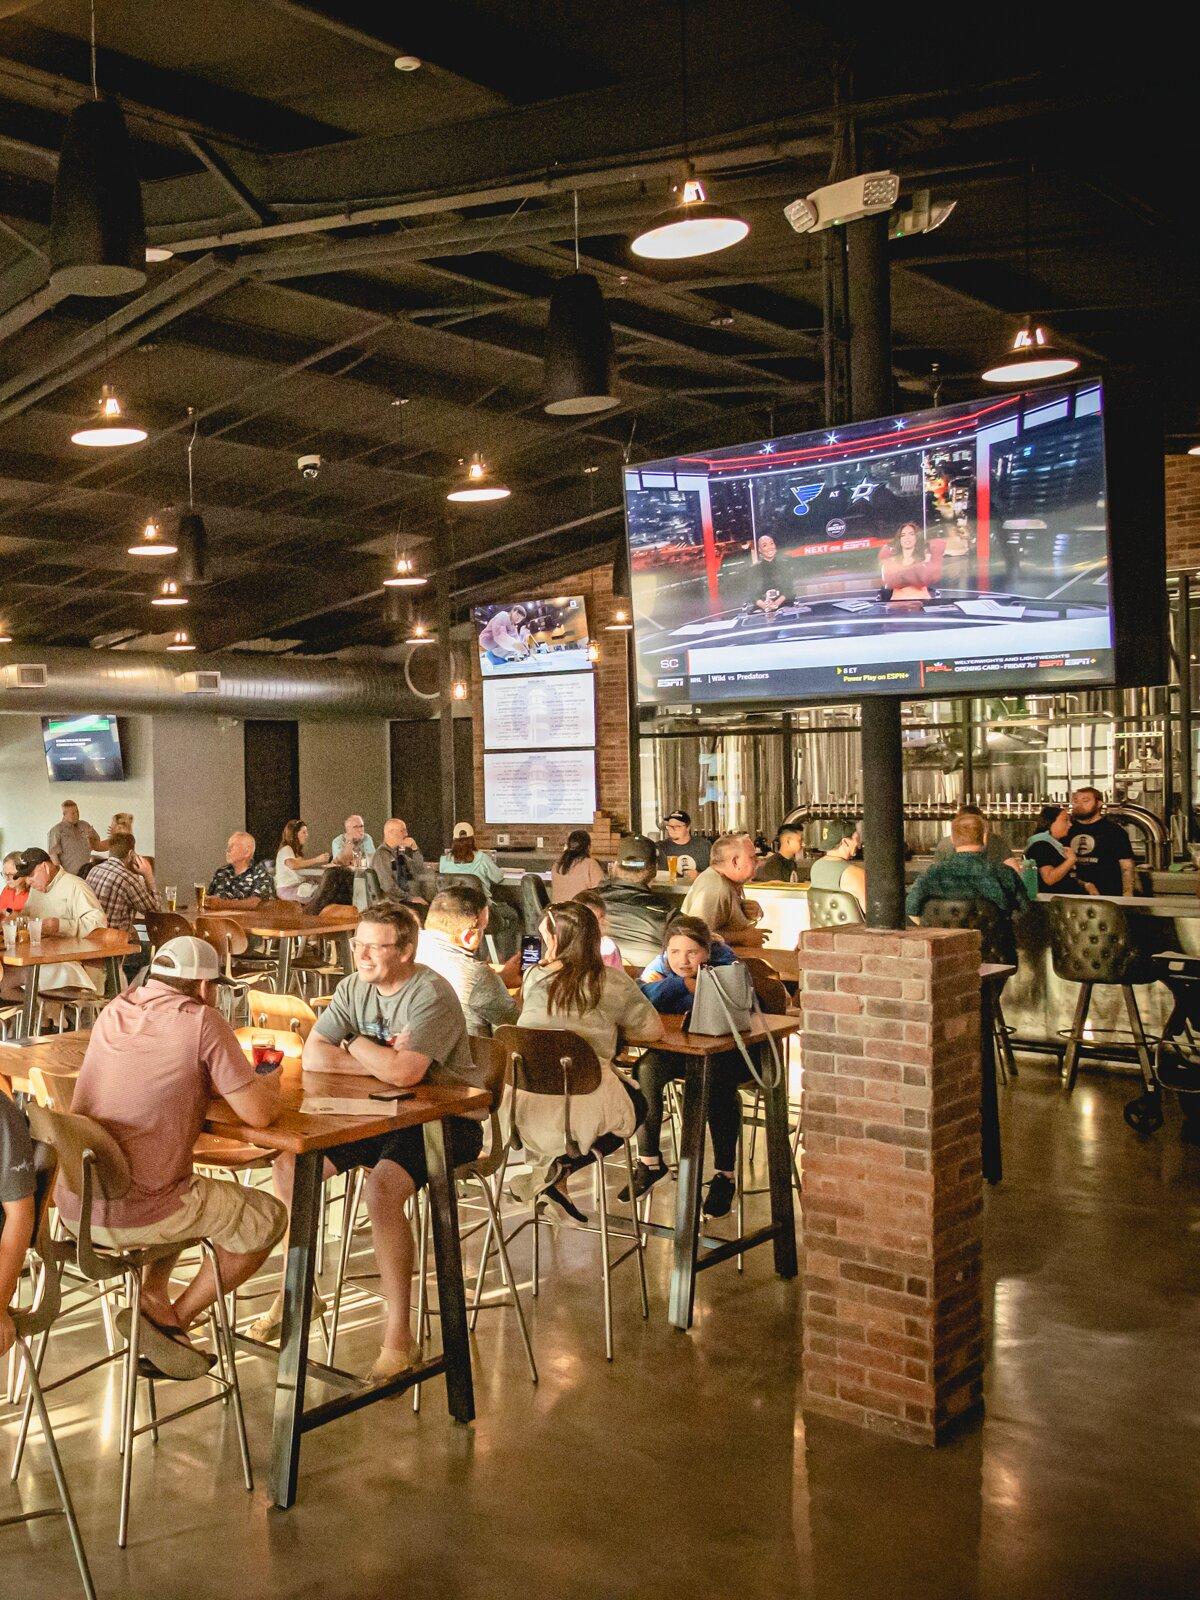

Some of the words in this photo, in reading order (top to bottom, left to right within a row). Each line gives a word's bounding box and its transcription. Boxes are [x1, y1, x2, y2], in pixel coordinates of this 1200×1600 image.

[804, 545, 829, 555] NEXT
[842, 539, 870, 550] ESPN
[660, 659, 679, 668] SC
[1003, 662, 1026, 670] FRIDAY
[863, 673, 877, 682] Play
[657, 678, 683, 687] ESPN
